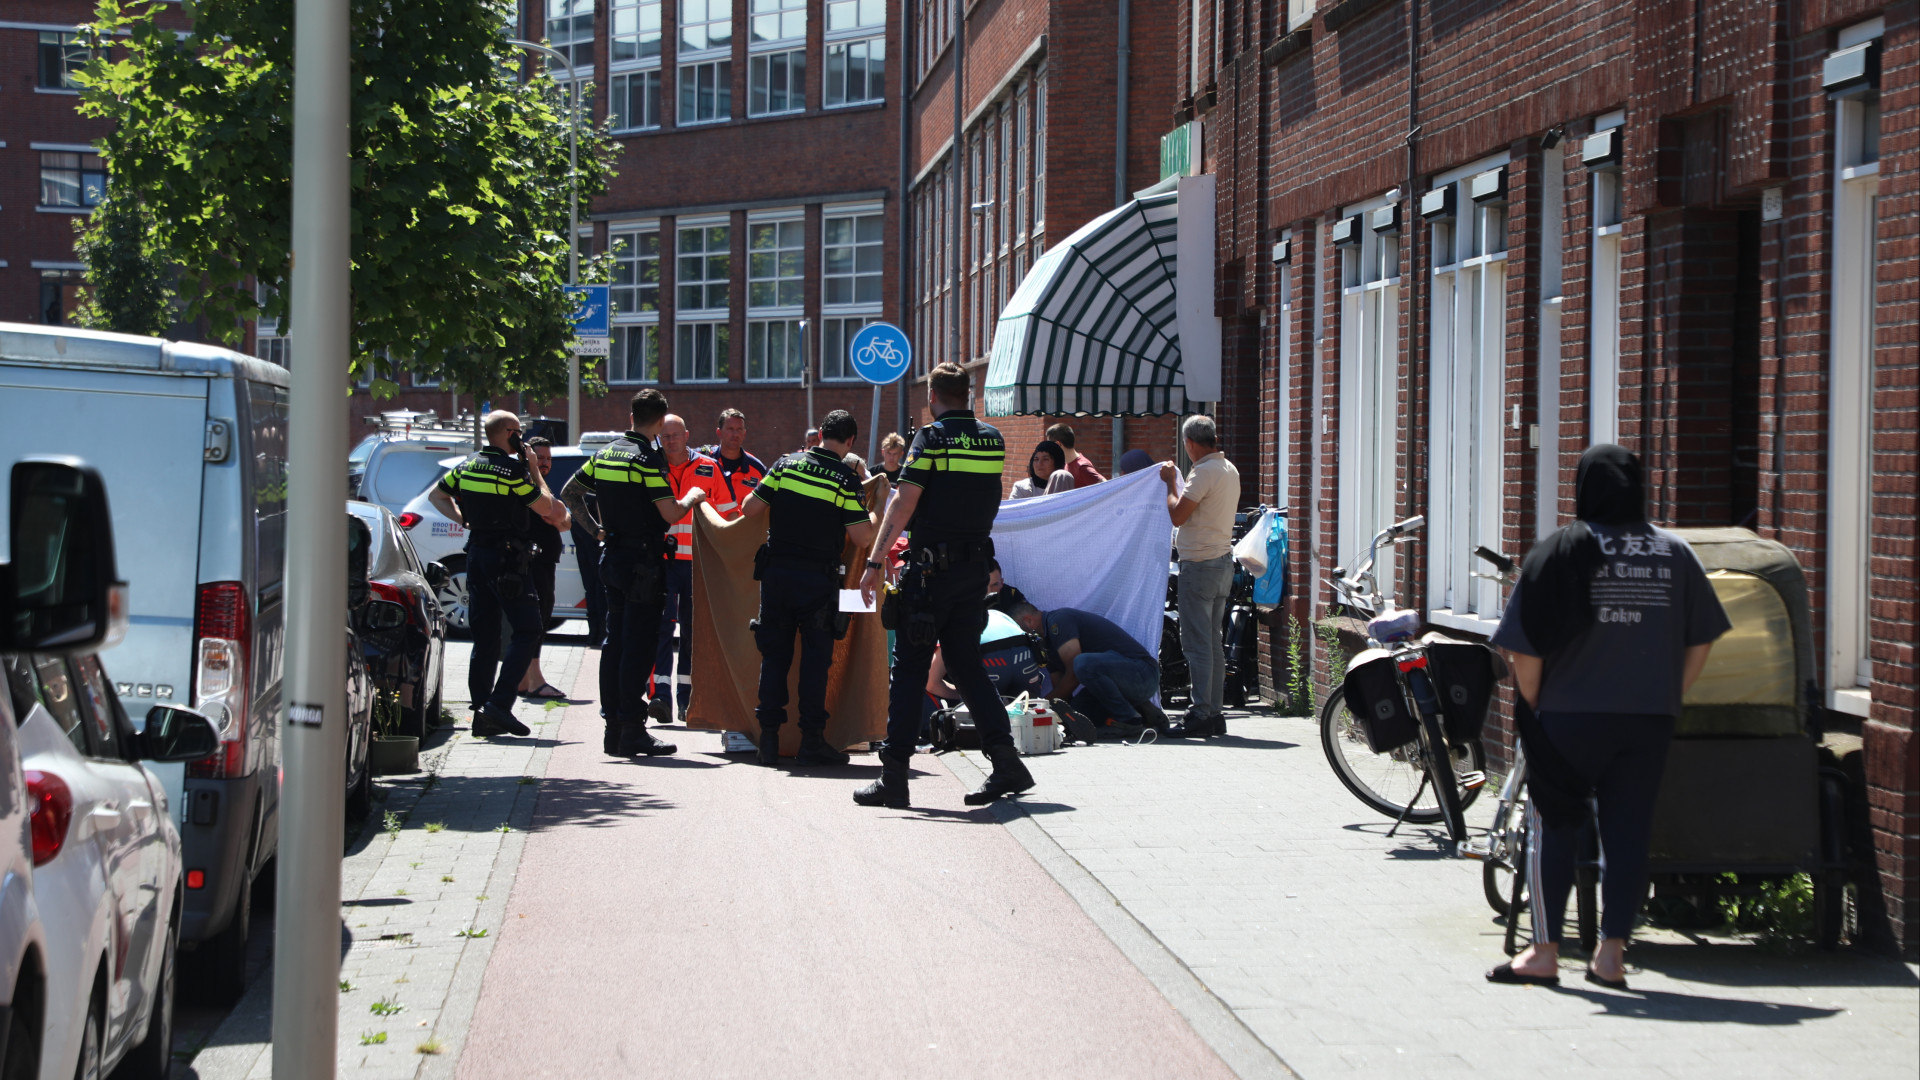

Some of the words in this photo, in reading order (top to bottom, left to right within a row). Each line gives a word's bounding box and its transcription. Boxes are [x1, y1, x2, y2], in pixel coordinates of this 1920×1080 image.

[954, 432, 999, 450] POLITIE
[792, 457, 837, 478] POLITIE
[1615, 562, 1652, 578] Time
[1657, 564, 1672, 579] in
[1599, 607, 1642, 626] Tokyo
[116, 682, 174, 700] XER
